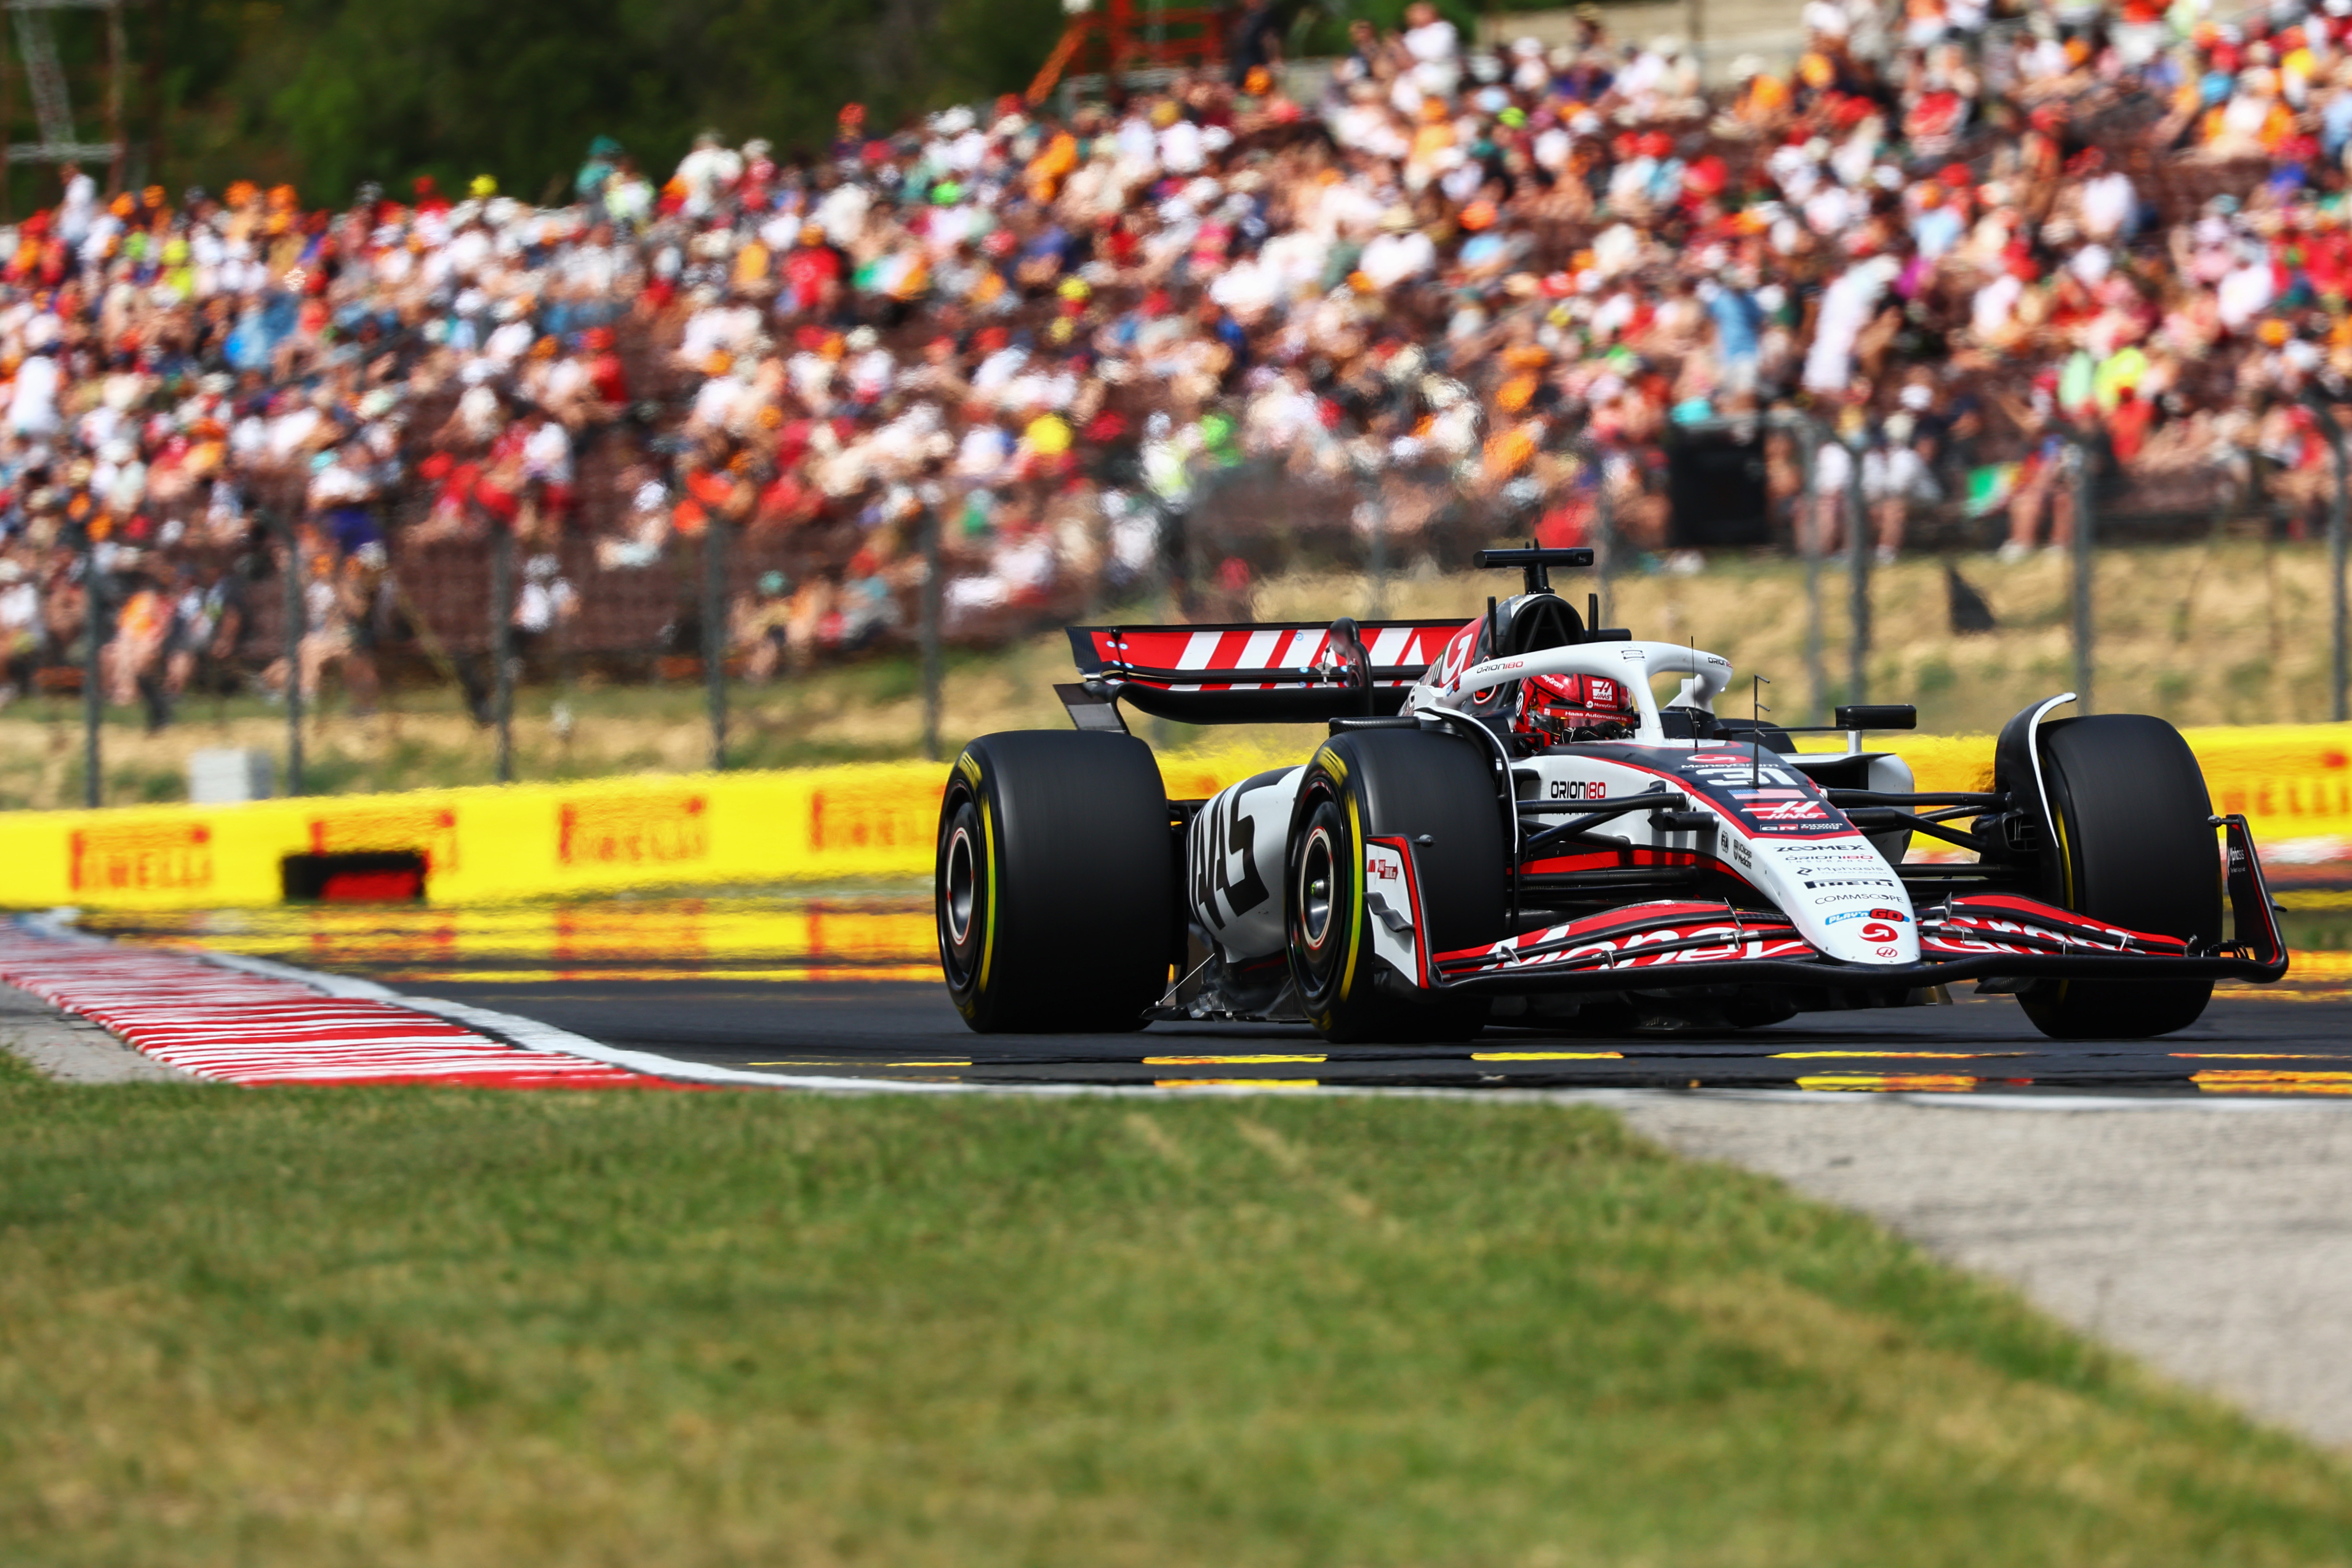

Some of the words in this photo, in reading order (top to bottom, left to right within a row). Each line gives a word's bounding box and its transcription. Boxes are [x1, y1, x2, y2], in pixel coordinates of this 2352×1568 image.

[1476, 661, 1524, 674] ORION180
[1585, 713, 1621, 721] Automation
[1696, 768, 1798, 786] 31
[1550, 780, 1606, 799] ORION180
[1804, 878, 1894, 889] PIRELLI
[1815, 894, 1904, 904] COMMSCOPE
[1829, 911, 1869, 923] PLAY'n
[1869, 908, 1904, 922] GO
